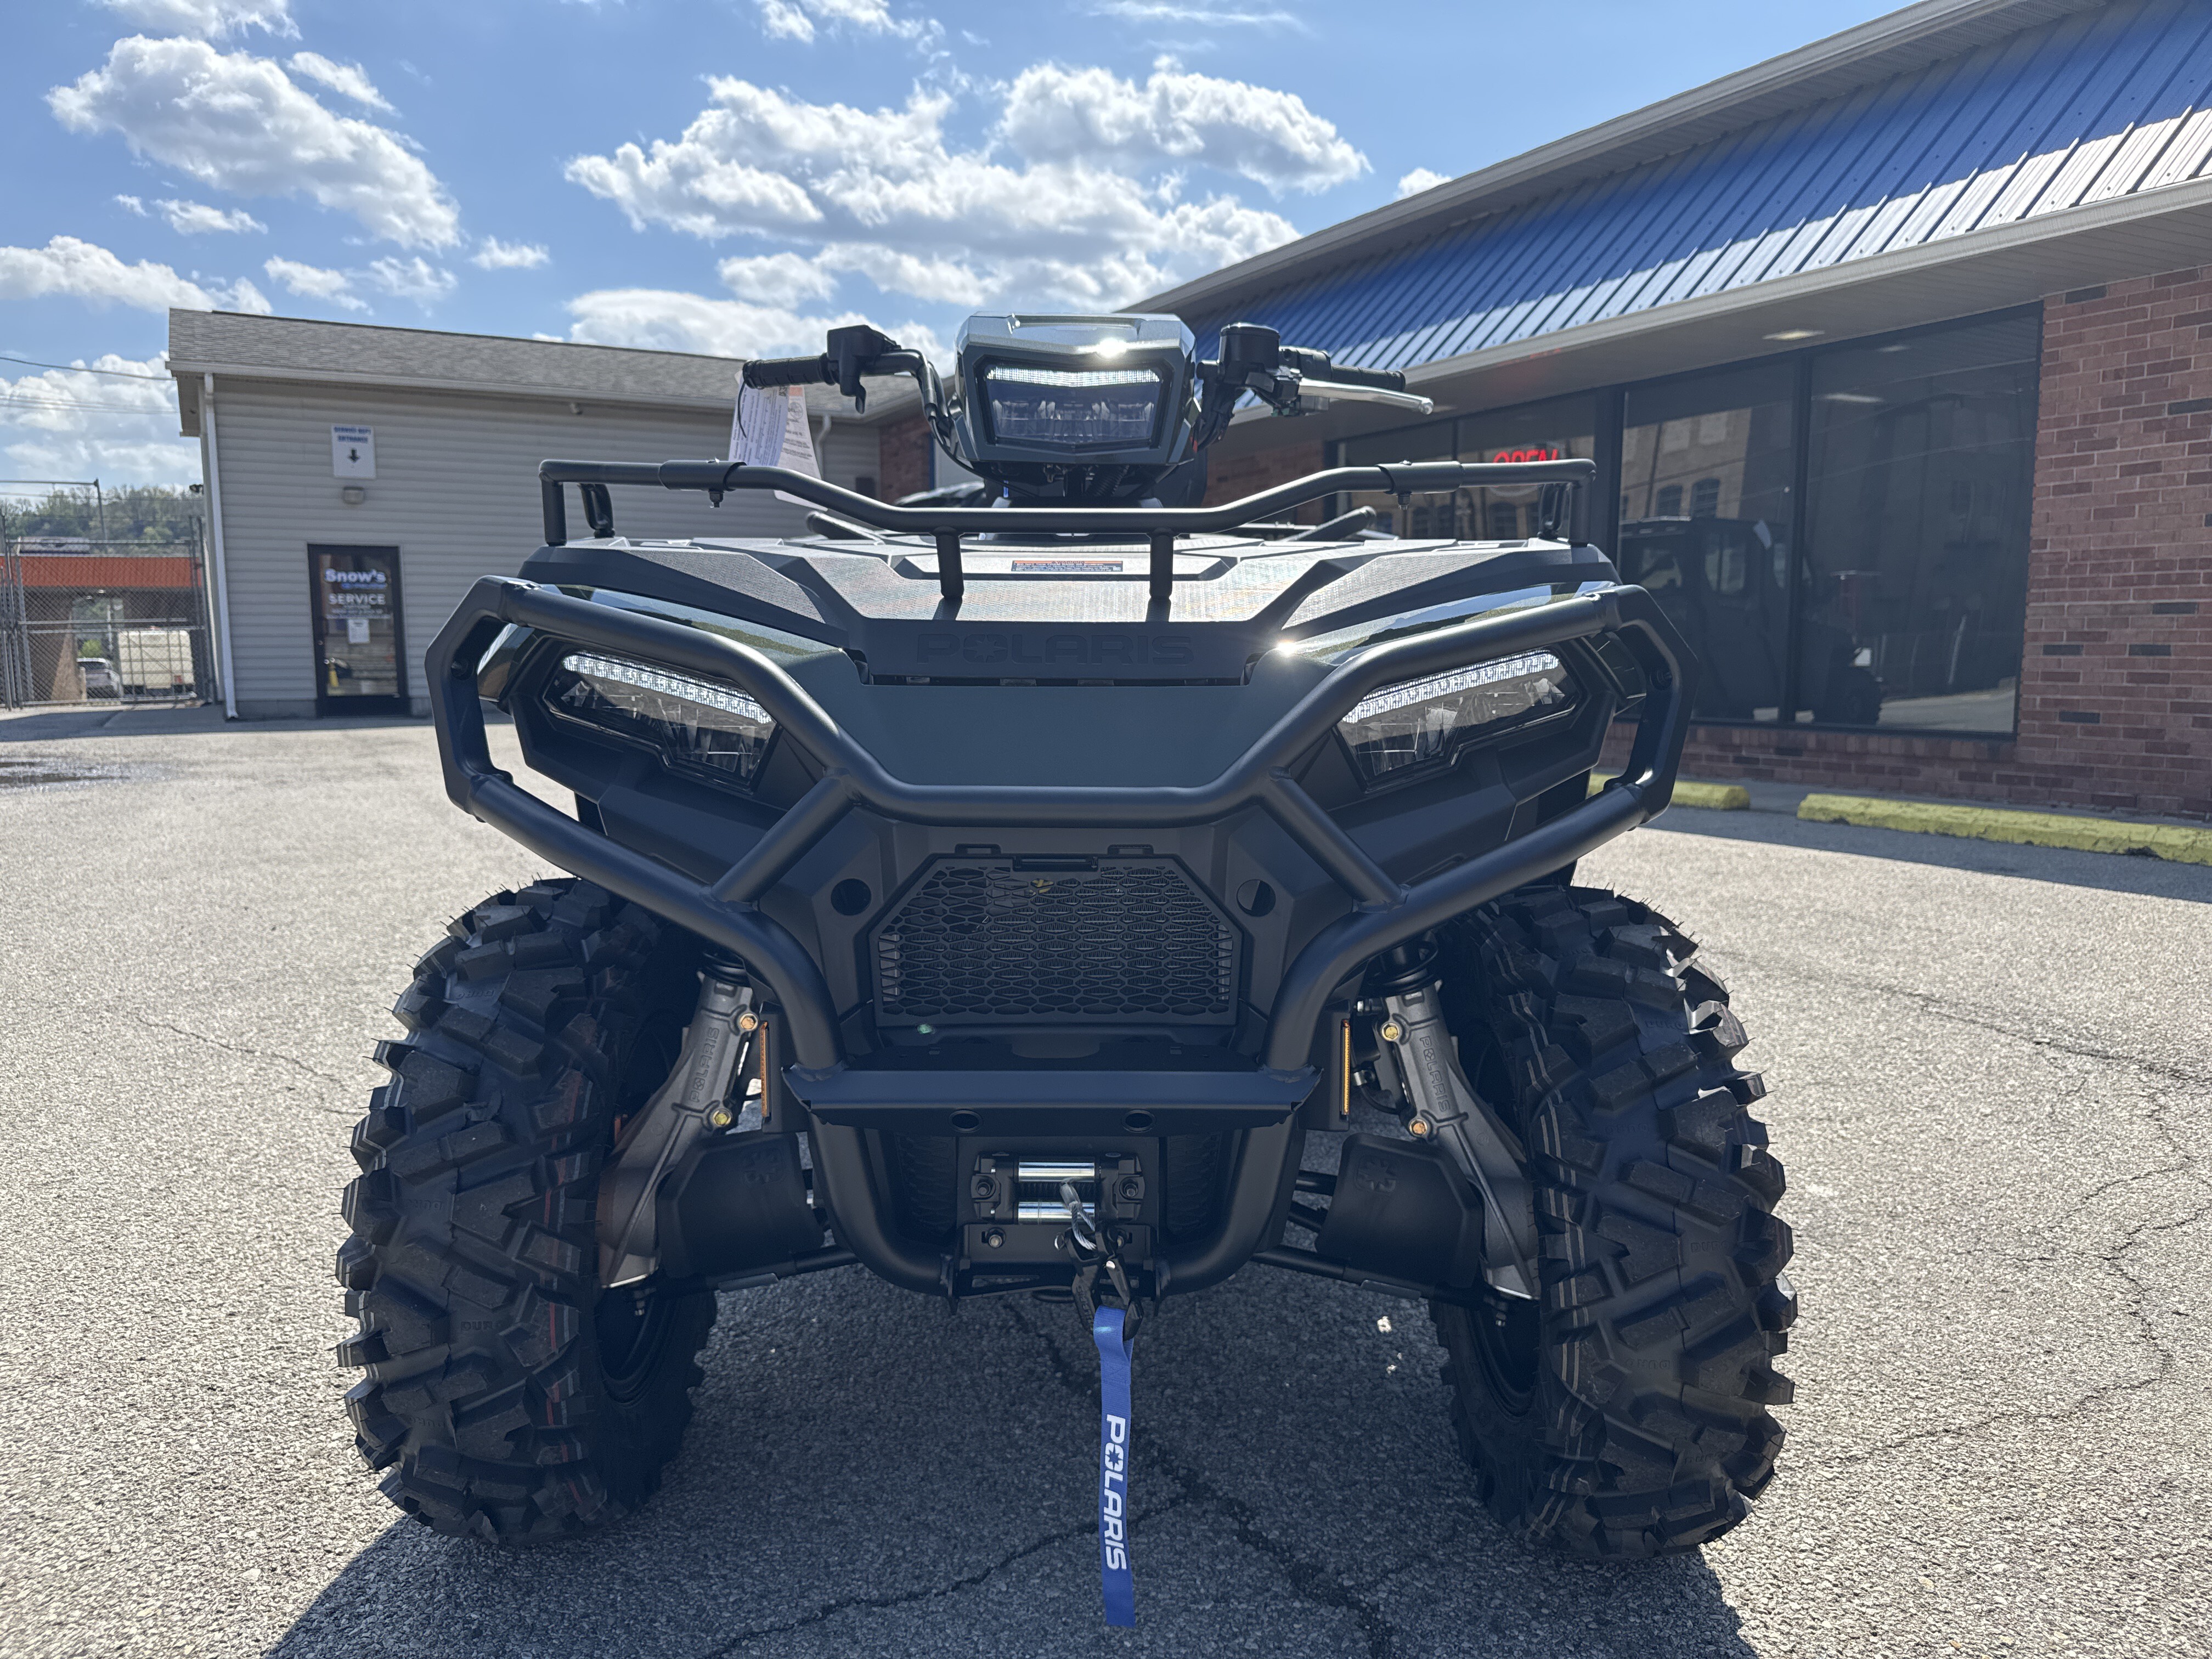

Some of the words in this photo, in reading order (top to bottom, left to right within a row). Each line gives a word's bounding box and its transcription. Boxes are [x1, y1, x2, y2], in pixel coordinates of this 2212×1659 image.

[325, 568, 386, 583] Snow's
[329, 593, 386, 605] SERVICE
[917, 634, 1194, 666] POLARIS
[690, 1027, 720, 1103] POLARIS
[1420, 1036, 1451, 1112] POLARIS
[1104, 1414, 1127, 1570] POLARIS
